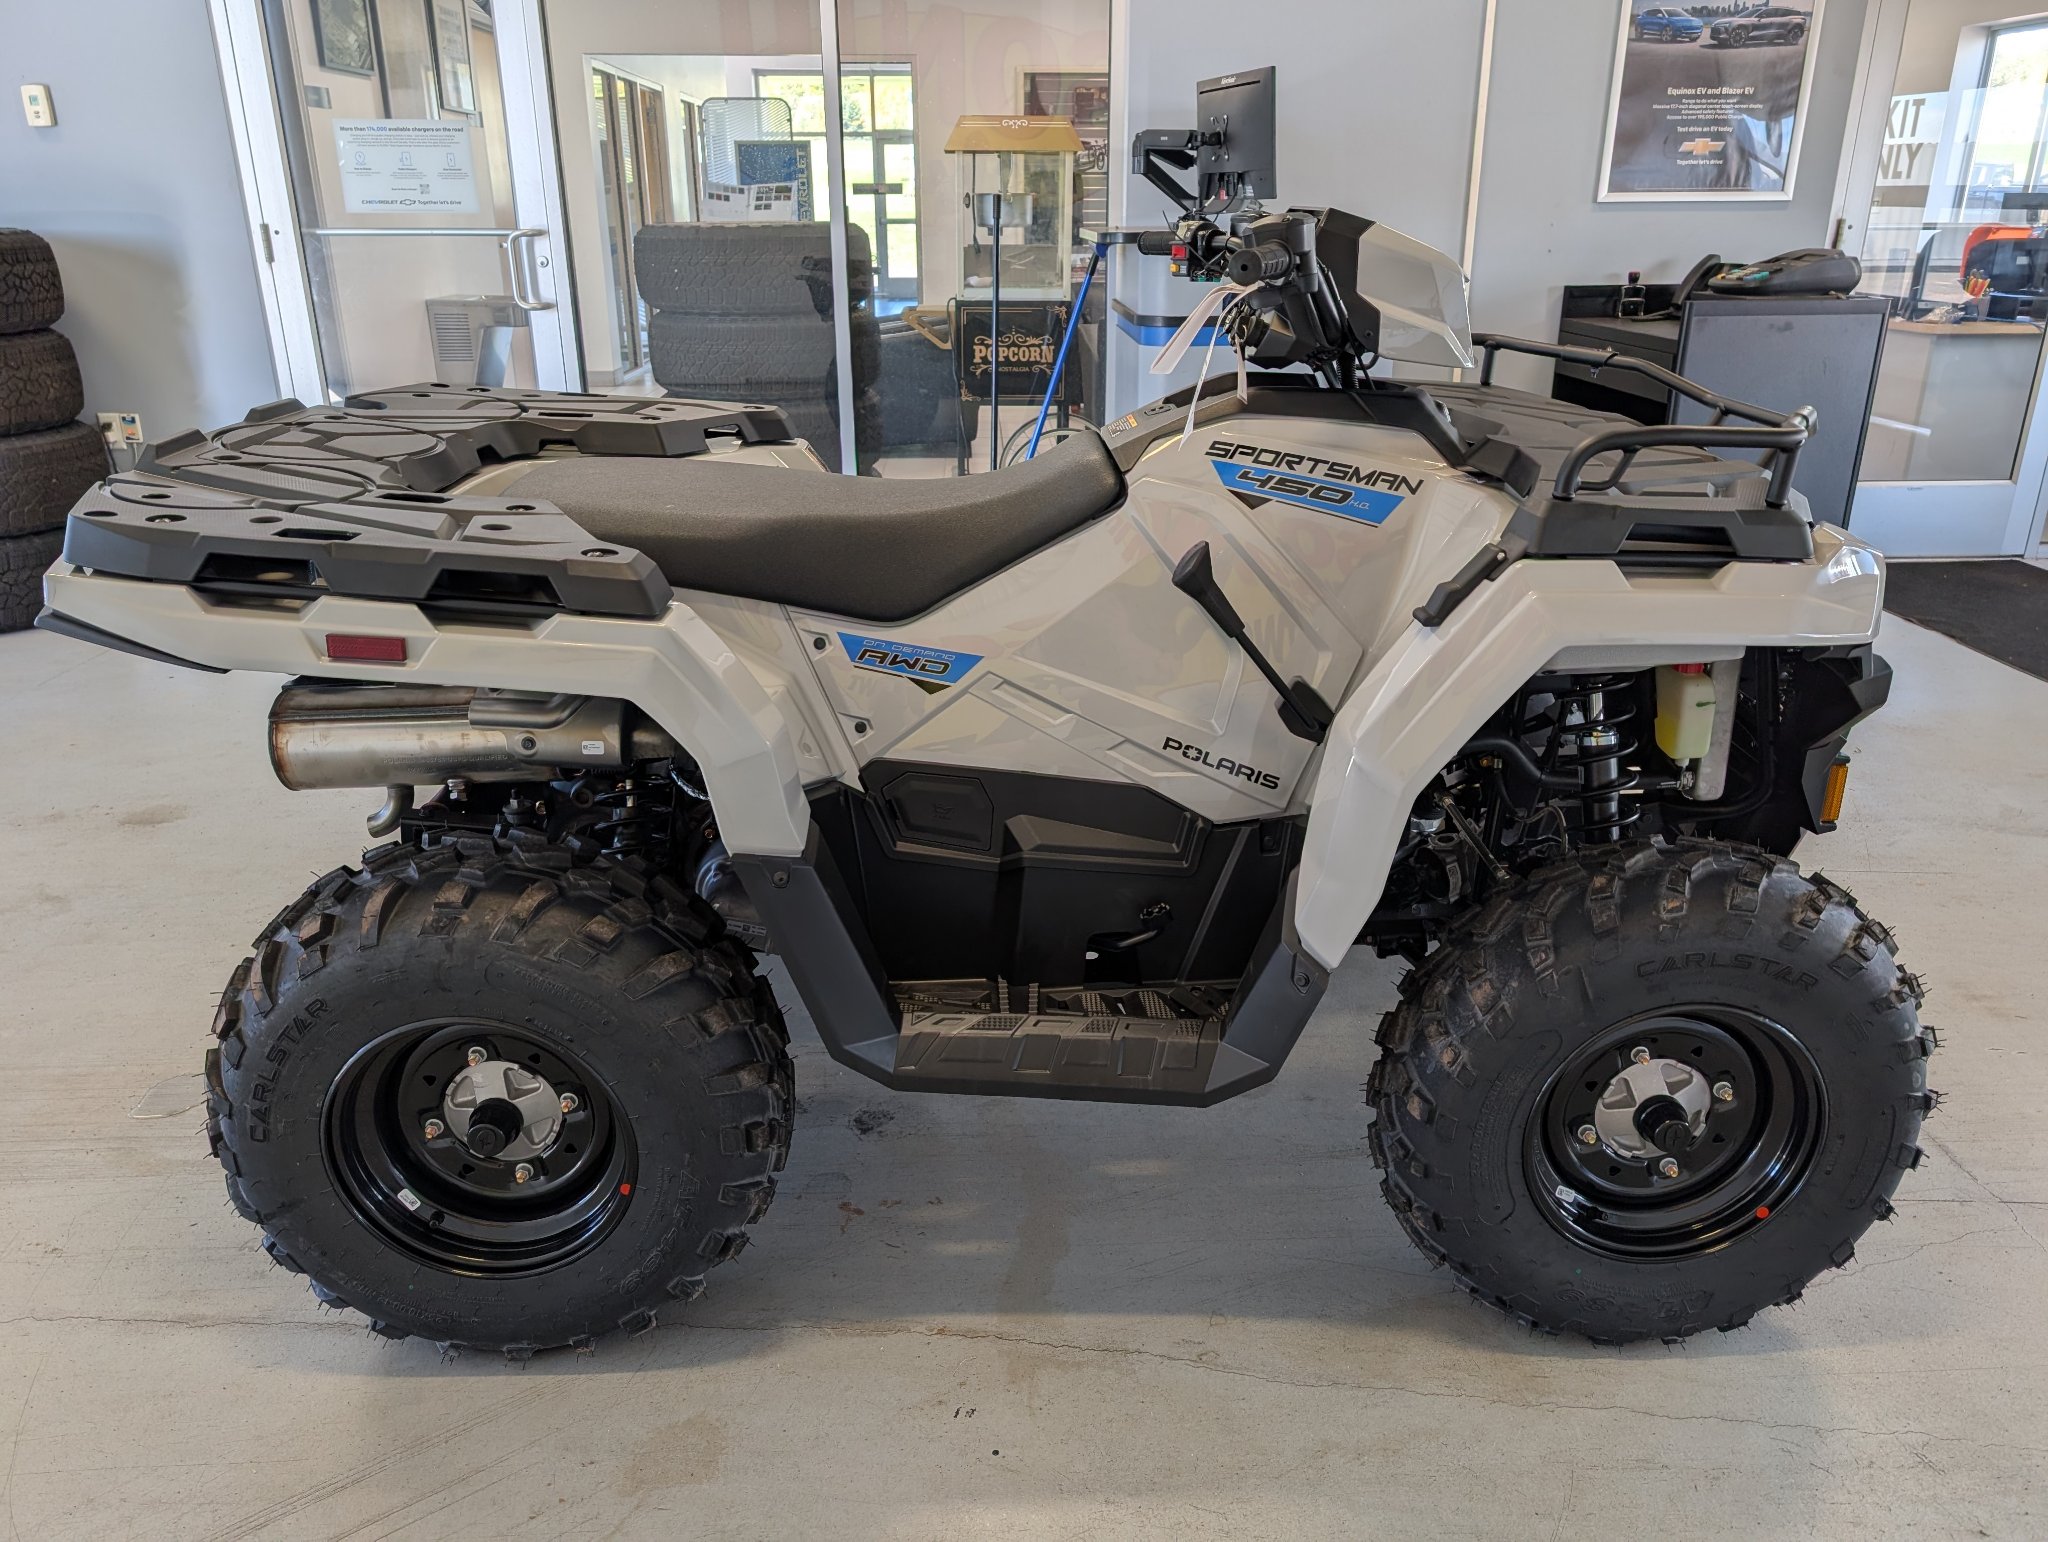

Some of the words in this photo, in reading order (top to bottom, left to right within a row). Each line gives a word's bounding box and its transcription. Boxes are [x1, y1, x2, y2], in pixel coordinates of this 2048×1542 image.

[1667, 87, 1696, 96] Equinox
[1696, 87, 1708, 95] EV
[1707, 87, 1721, 95] and
[1721, 87, 1744, 95] Blazer
[973, 345, 1055, 363] POPCORN
[1204, 440, 1424, 496] SPORTSMAN
[1236, 469, 1355, 506] 450
[856, 647, 952, 676] AWD
[1161, 736, 1281, 791] POLARIS
[1634, 951, 1820, 992] CARLSTAR
[249, 998, 329, 1143] CARLSTAR
